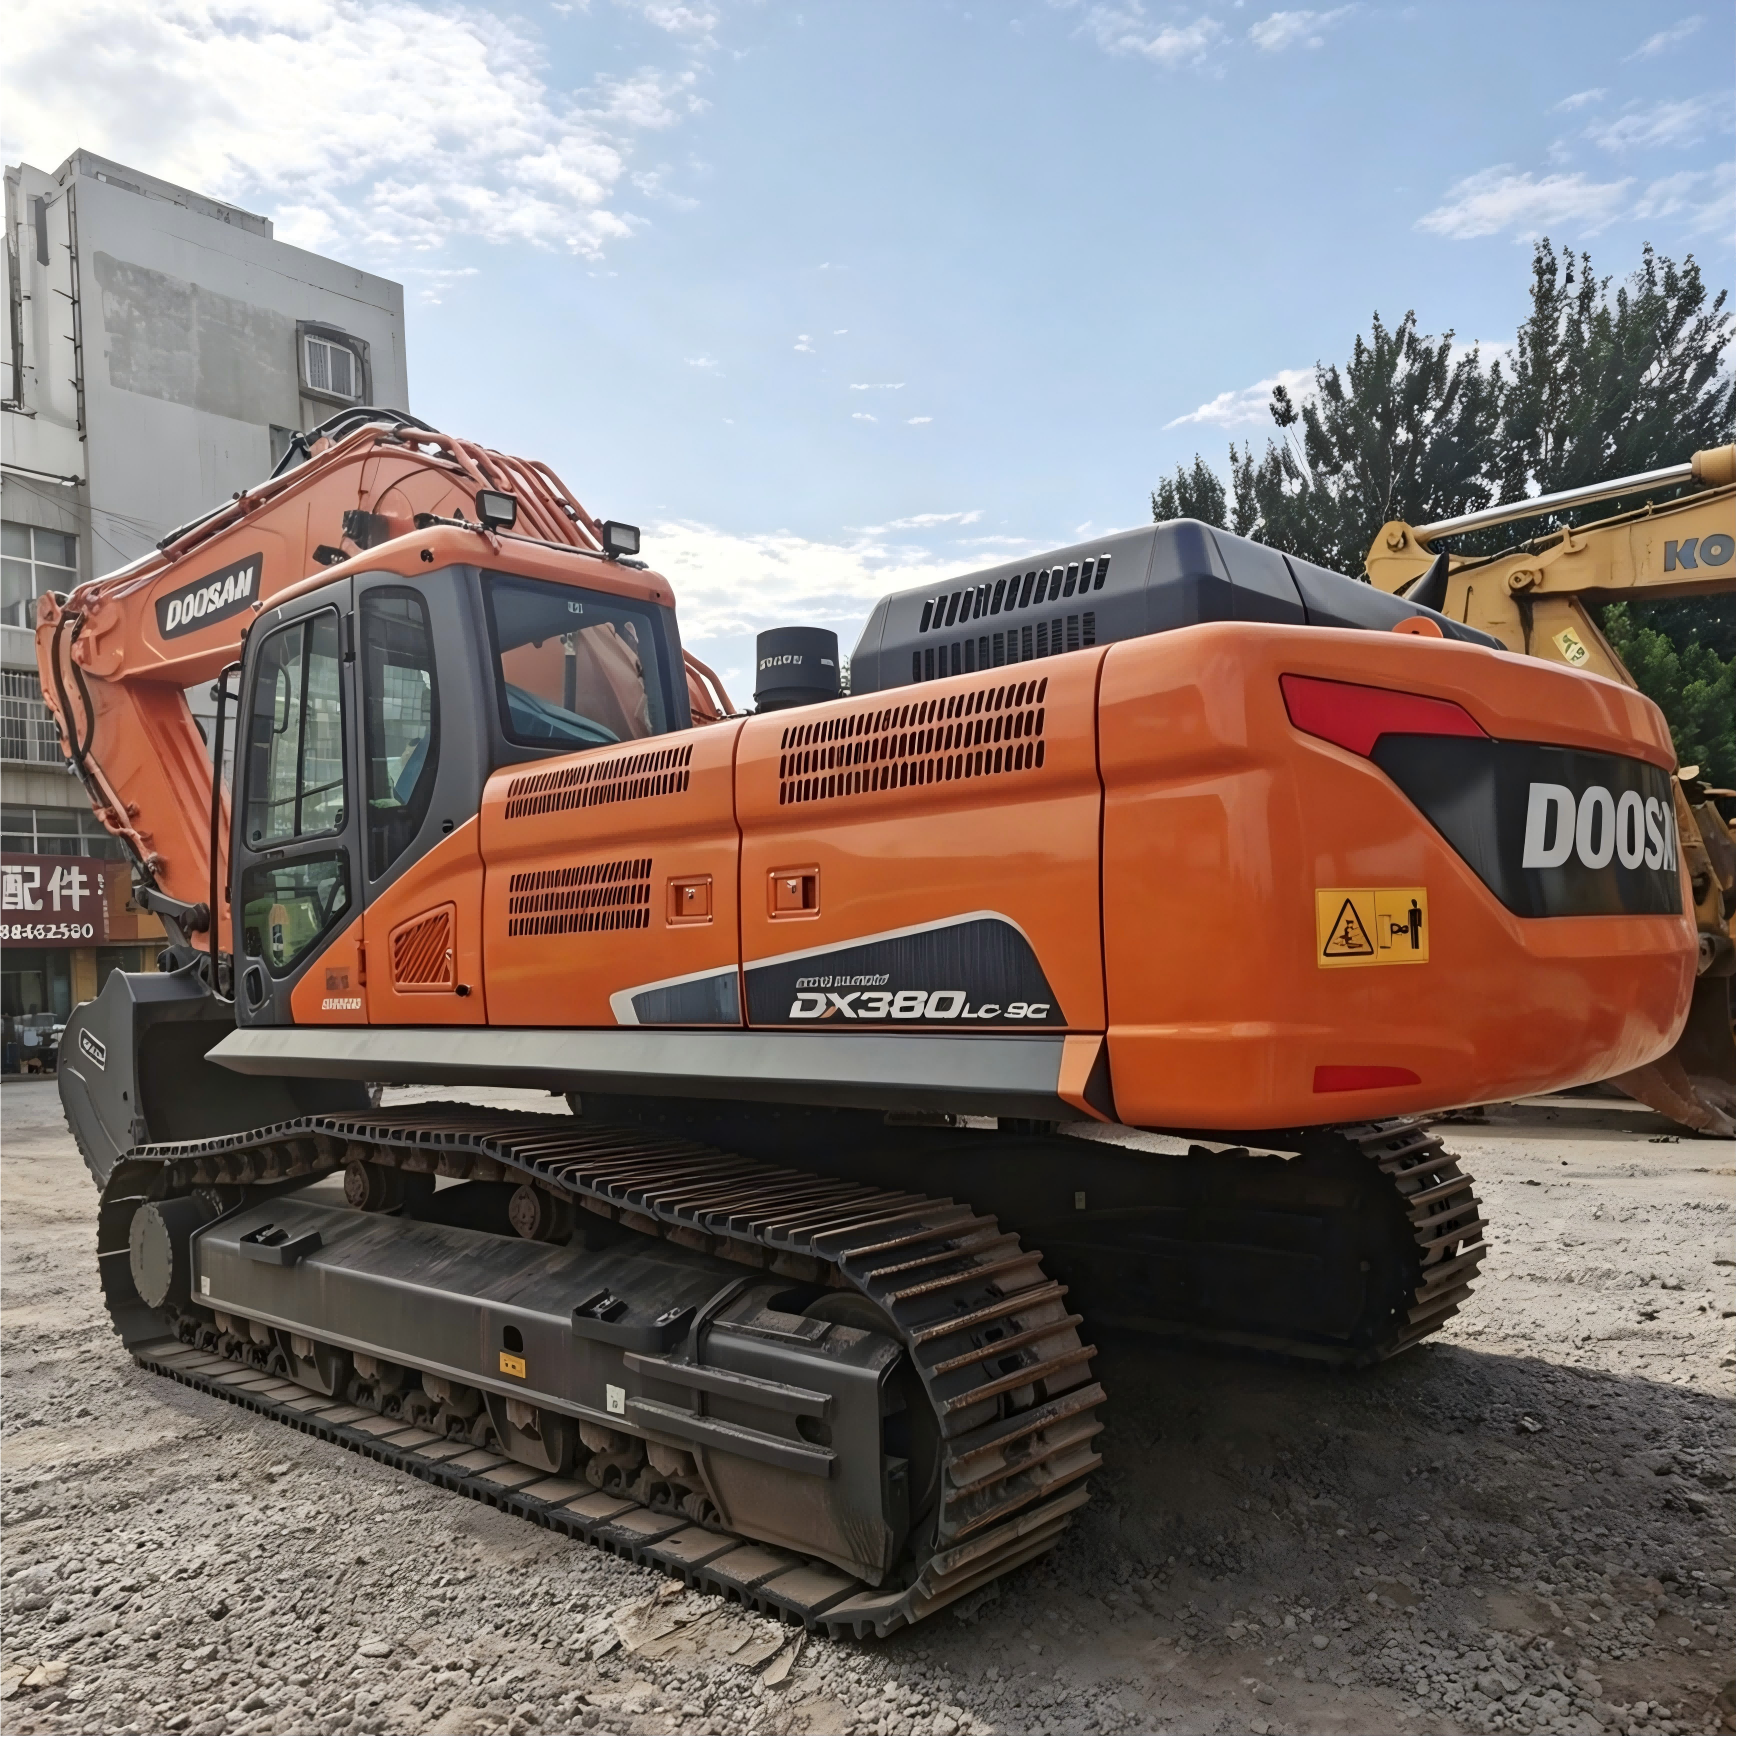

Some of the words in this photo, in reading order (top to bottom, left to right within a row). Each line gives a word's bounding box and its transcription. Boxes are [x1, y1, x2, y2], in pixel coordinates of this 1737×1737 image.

[1664, 534, 1735, 572] KO
[165, 566, 254, 631] DOOSAN
[0, 866, 90, 911] 配件
